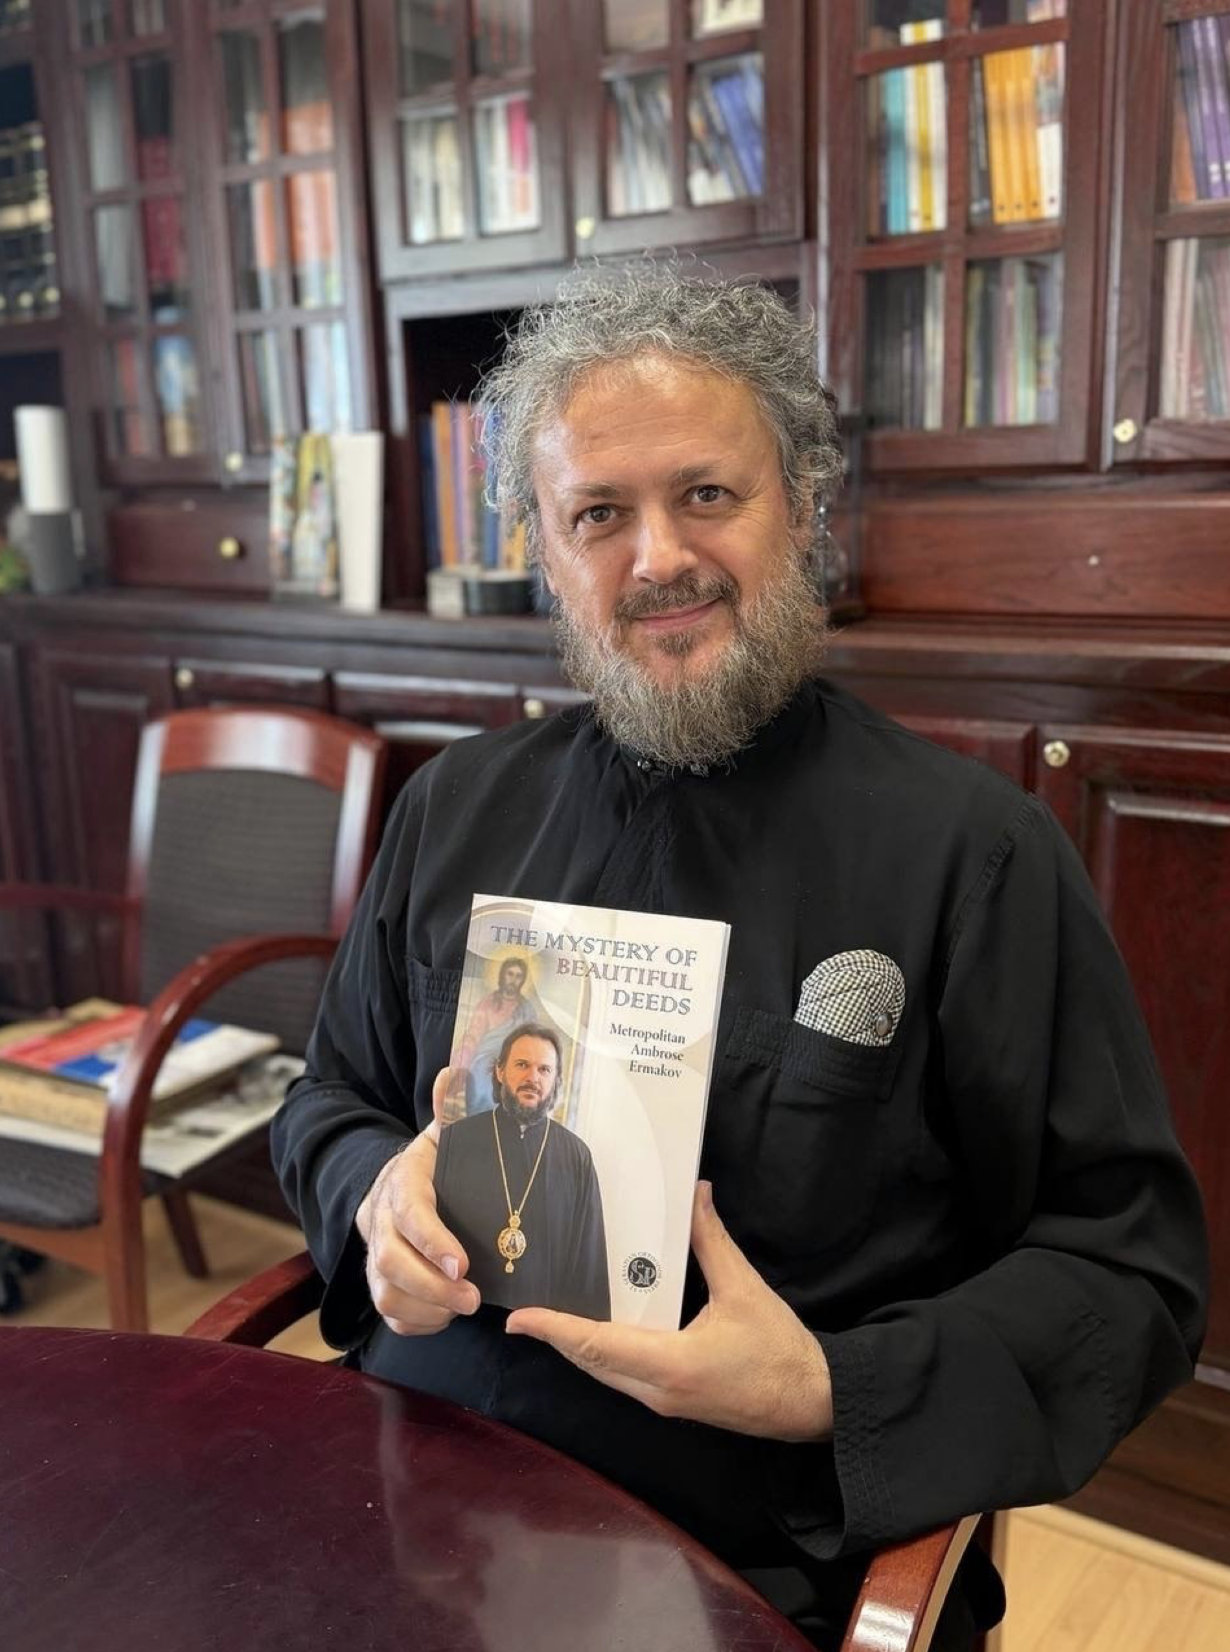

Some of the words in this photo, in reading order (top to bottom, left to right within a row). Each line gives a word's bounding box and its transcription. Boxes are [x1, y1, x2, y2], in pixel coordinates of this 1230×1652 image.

[491, 926, 538, 947] THE
[545, 932, 659, 961] MYSTERY
[665, 948, 698, 967] OF
[556, 957, 693, 991] BEAUTIFUL
[612, 989, 691, 1015] DEEDS
[609, 1023, 686, 1045] Metropolitan
[630, 1043, 684, 1062] Ambrose
[629, 1061, 682, 1079] Ermakov
